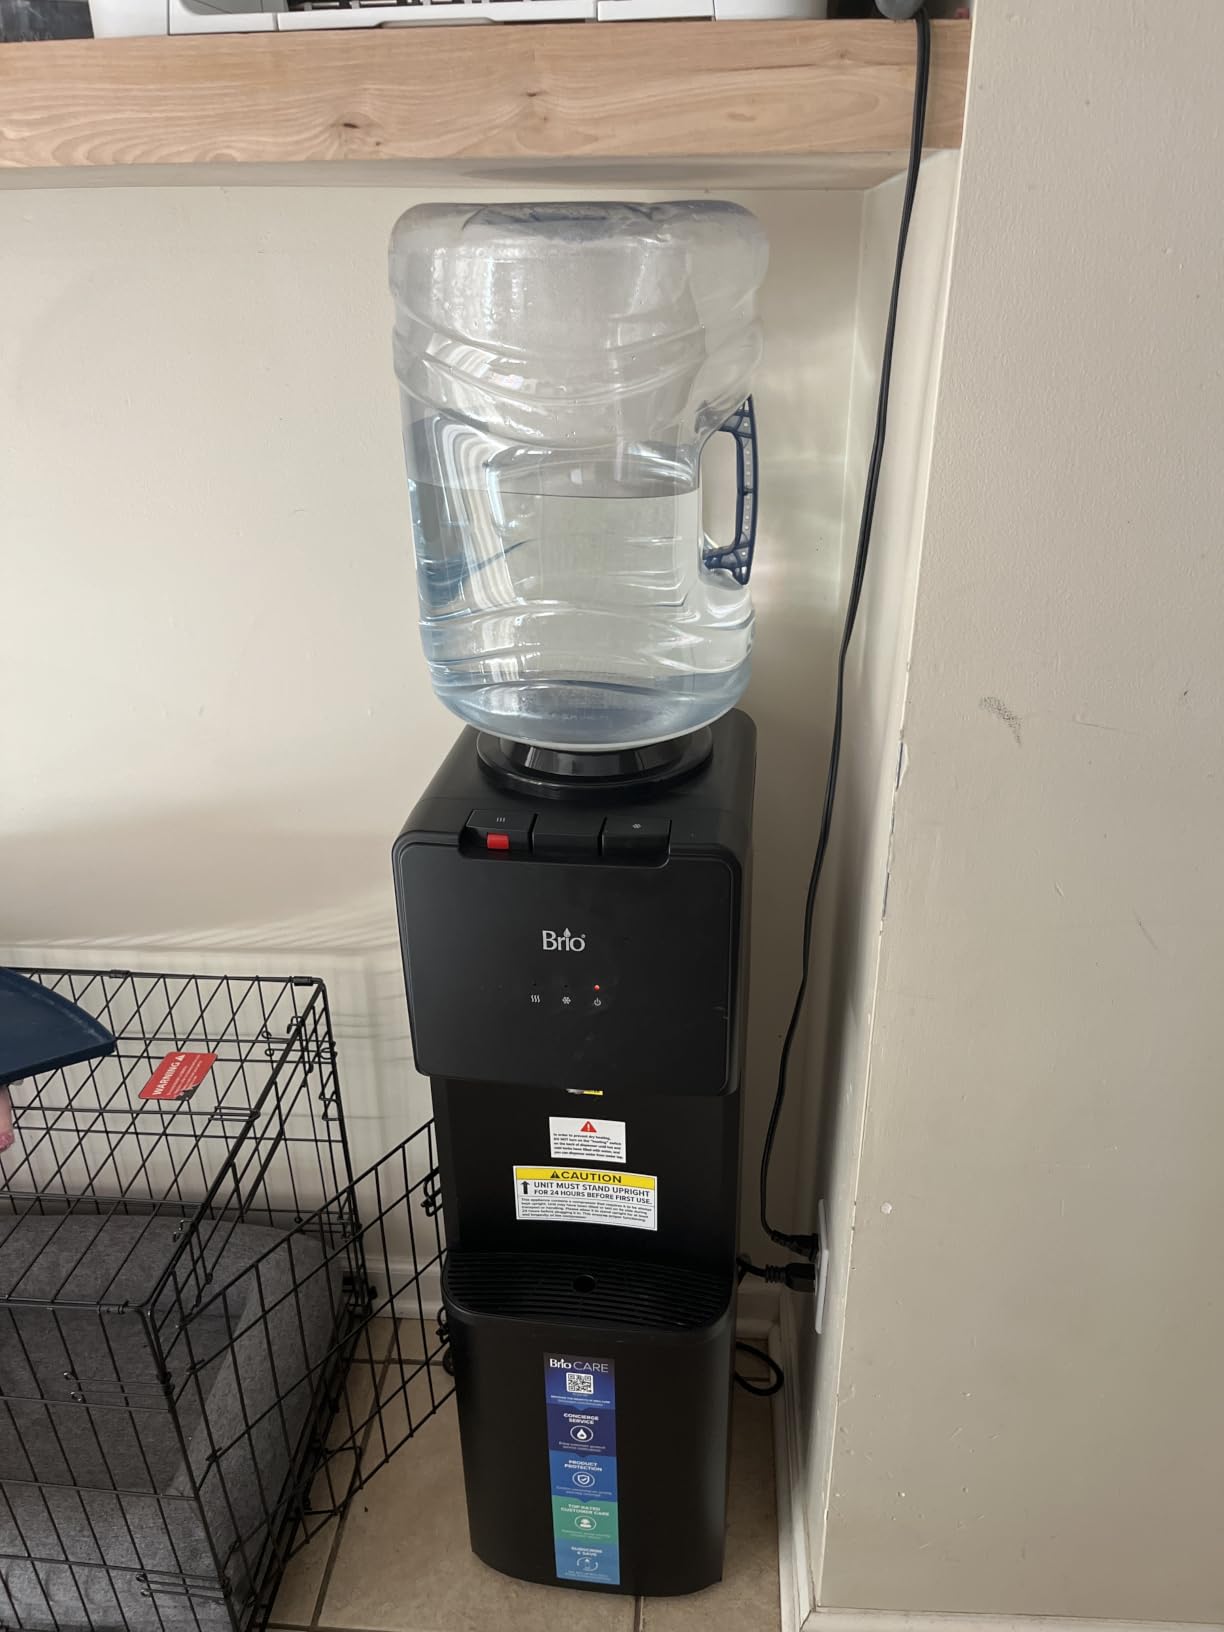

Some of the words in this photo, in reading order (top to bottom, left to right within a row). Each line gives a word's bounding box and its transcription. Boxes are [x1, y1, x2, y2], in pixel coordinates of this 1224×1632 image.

[542, 928, 586, 952] Brio
[152, 1061, 181, 1096] WARNING
[561, 1171, 622, 1183] CAUTION
[556, 1182, 580, 1190] MUST
[582, 1184, 610, 1192] STAND
[612, 1187, 650, 1197] UPRIGHT
[587, 1192, 614, 1200] BEFORE
[549, 1358, 572, 1369] Brio
[573, 1361, 609, 1373] CARE
[563, 1412, 599, 1421] CONCIERGE
[564, 1463, 603, 1472] PROTECTION
[568, 1459, 598, 1467] PRODUCT
